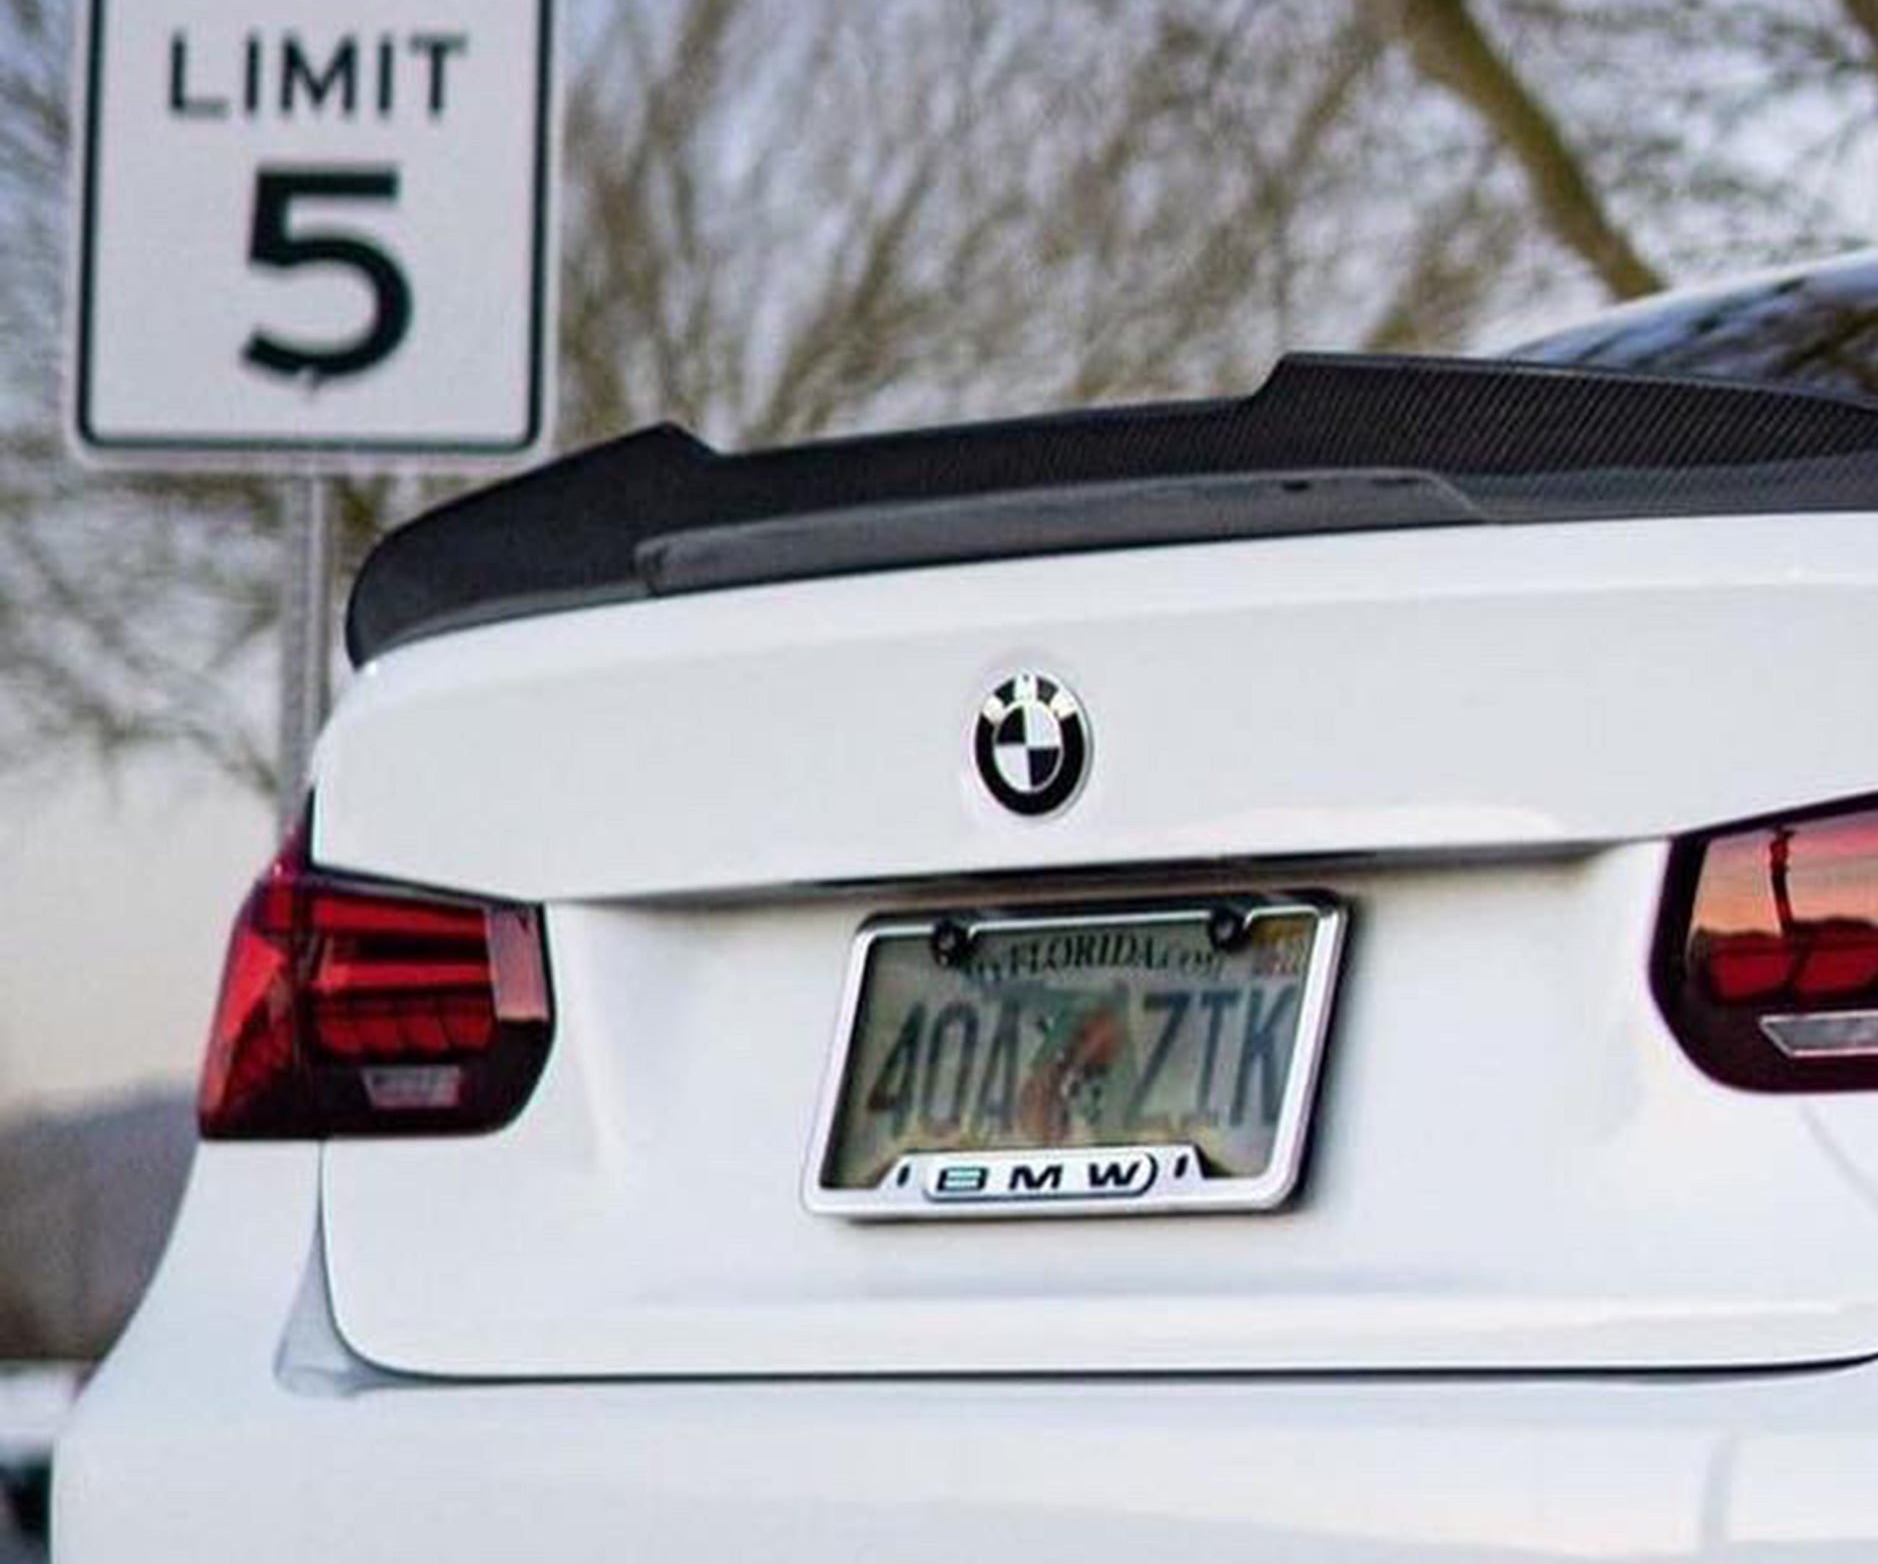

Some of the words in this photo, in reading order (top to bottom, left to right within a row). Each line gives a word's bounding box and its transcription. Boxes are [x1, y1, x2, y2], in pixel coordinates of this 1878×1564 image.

[168, 31, 470, 120] LIMIT
[241, 168, 415, 383] 5
[936, 1160, 1142, 1193] BMW
